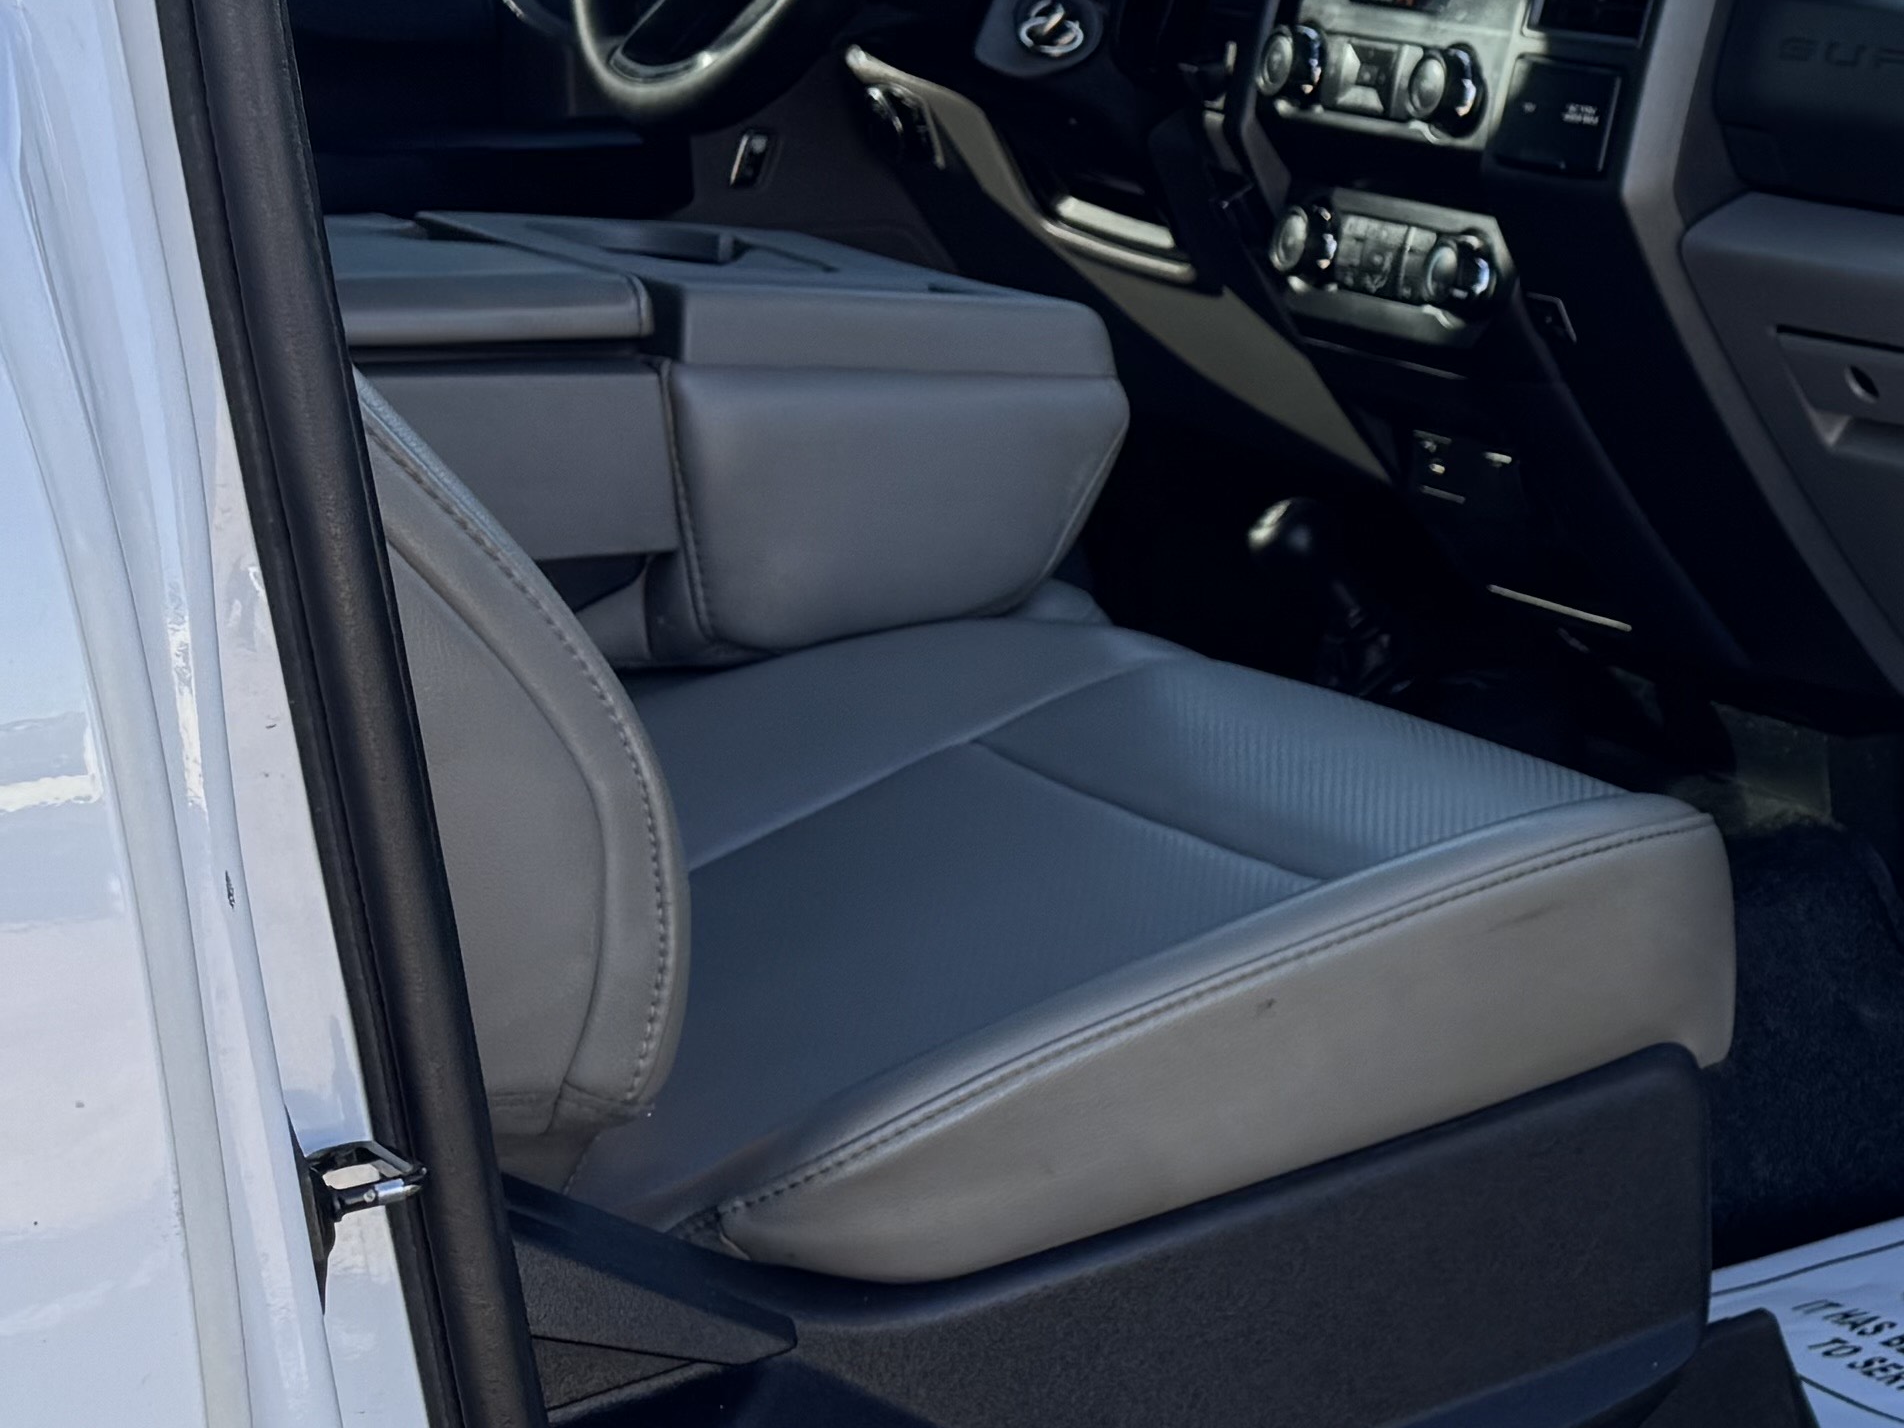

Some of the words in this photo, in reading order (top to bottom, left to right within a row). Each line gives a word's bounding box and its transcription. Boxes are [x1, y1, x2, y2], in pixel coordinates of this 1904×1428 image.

[1791, 1298, 1845, 1316] IT
[1821, 1307, 1898, 1339] HAS
[1807, 1336, 1865, 1359] TO
